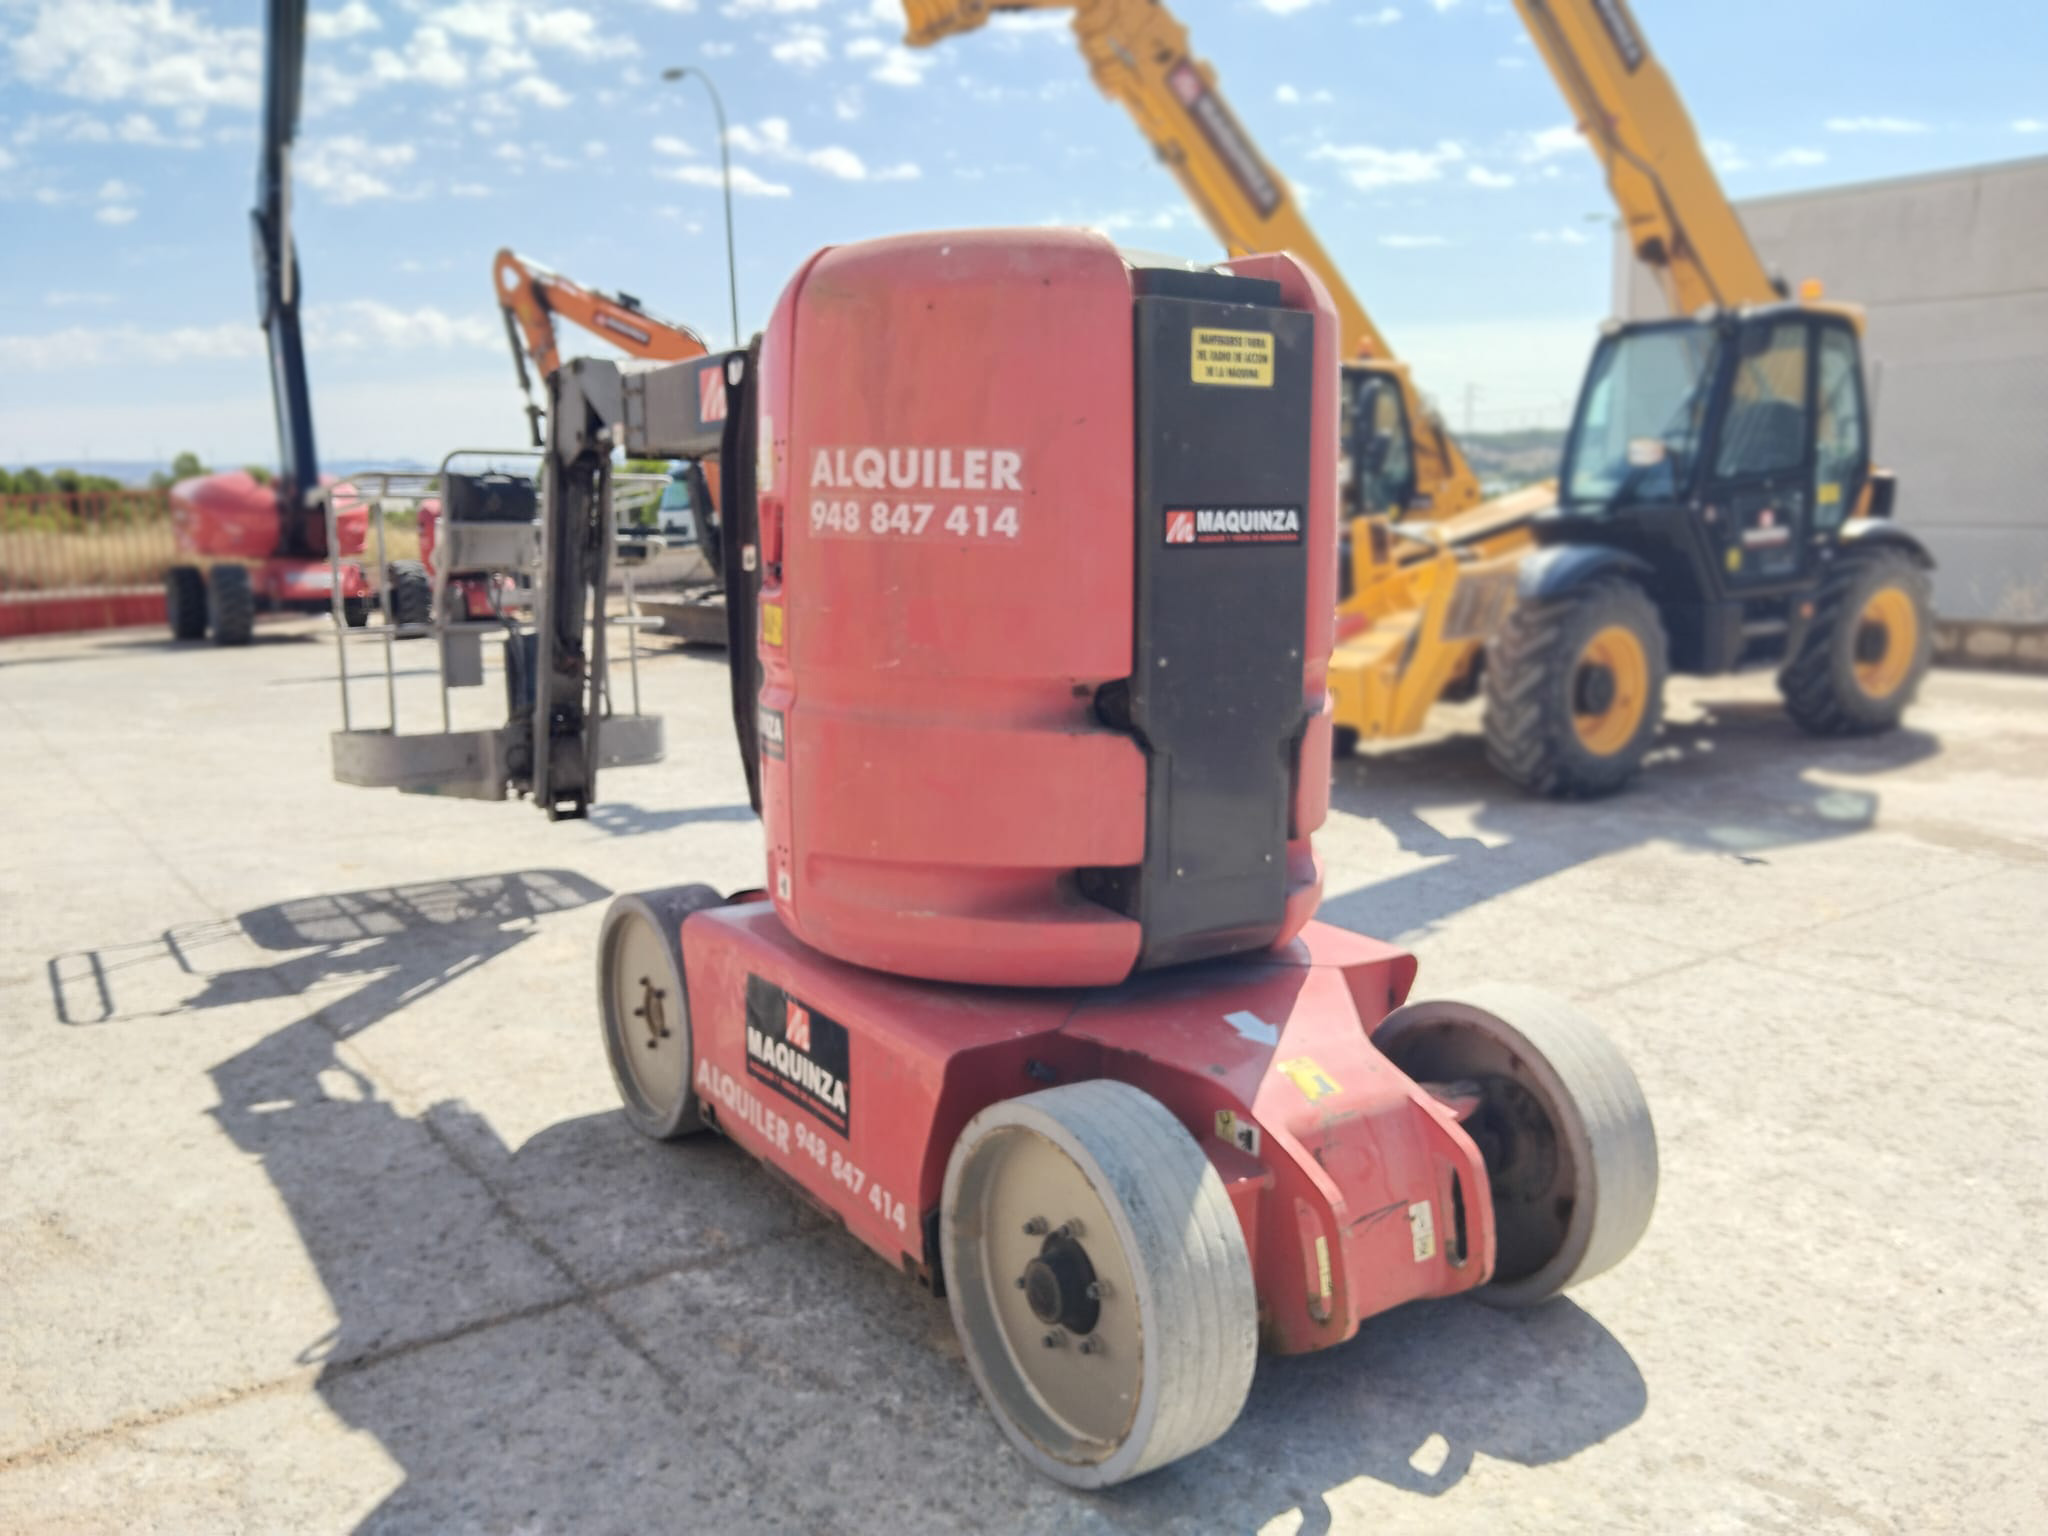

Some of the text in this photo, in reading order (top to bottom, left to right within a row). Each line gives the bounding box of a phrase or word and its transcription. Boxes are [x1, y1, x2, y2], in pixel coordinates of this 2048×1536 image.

[810, 447, 1023, 491] ALQUILER
[810, 499, 1019, 538] 948 847 414
[1197, 508, 1299, 533] MAQUINZA
[747, 1026, 847, 1114] MAQUINZA
[696, 1058, 790, 1155] ALQUILER
[794, 1122, 827, 1168] 948
[831, 1149, 866, 1194] 847
[868, 1183, 906, 1231] 414
